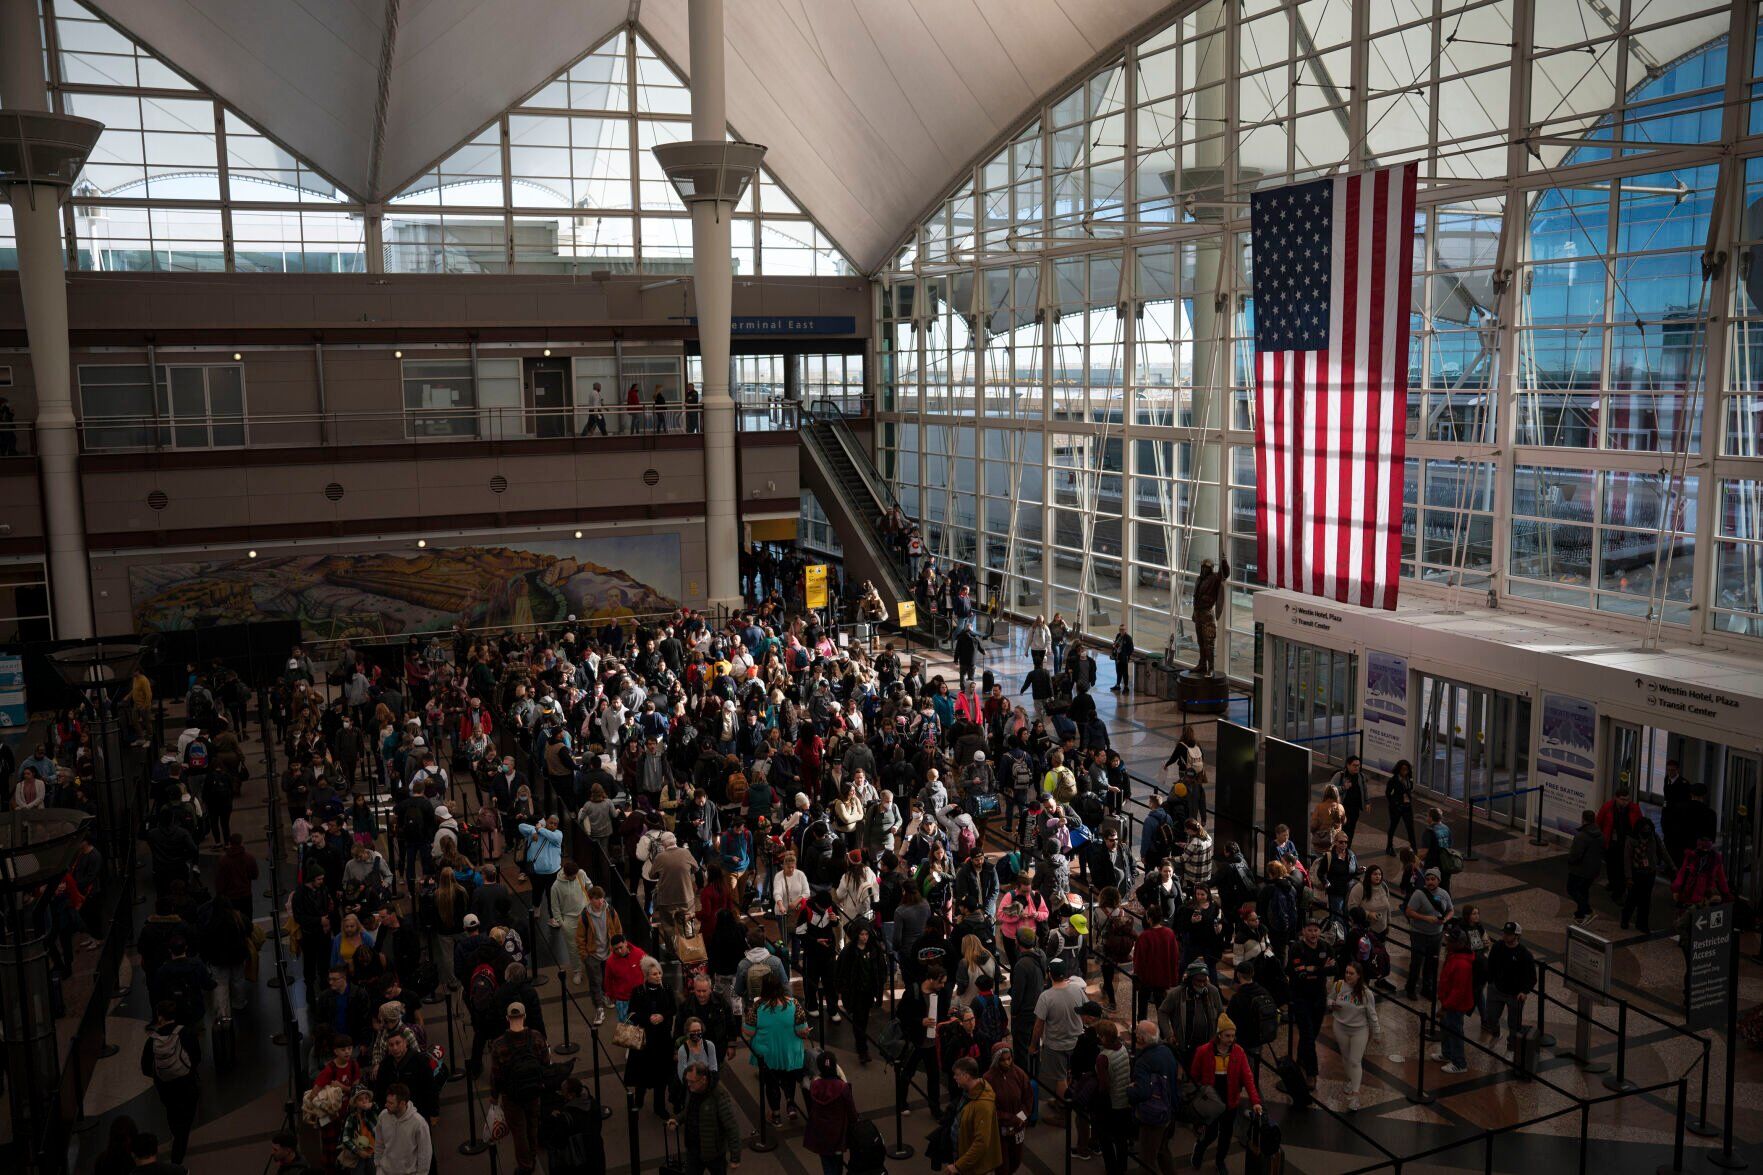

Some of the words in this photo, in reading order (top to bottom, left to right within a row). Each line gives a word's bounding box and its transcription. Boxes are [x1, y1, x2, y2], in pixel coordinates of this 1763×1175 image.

[731, 319, 782, 329] erminal
[788, 320, 815, 329] East
[1298, 607, 1314, 617] Westin
[1329, 614, 1342, 622] Plaza
[1298, 618, 1314, 627] Transit
[1314, 621, 1331, 630] Center
[1658, 683, 1687, 697] Westin
[1688, 690, 1714, 703] Hotel,
[1715, 695, 1740, 708] Plaza
[1658, 698, 1686, 711] Transit
[1687, 705, 1717, 718] Center
[1545, 781, 1559, 791] FREE
[1693, 933, 1729, 949] Restricted
[1692, 949, 1716, 960] Access
